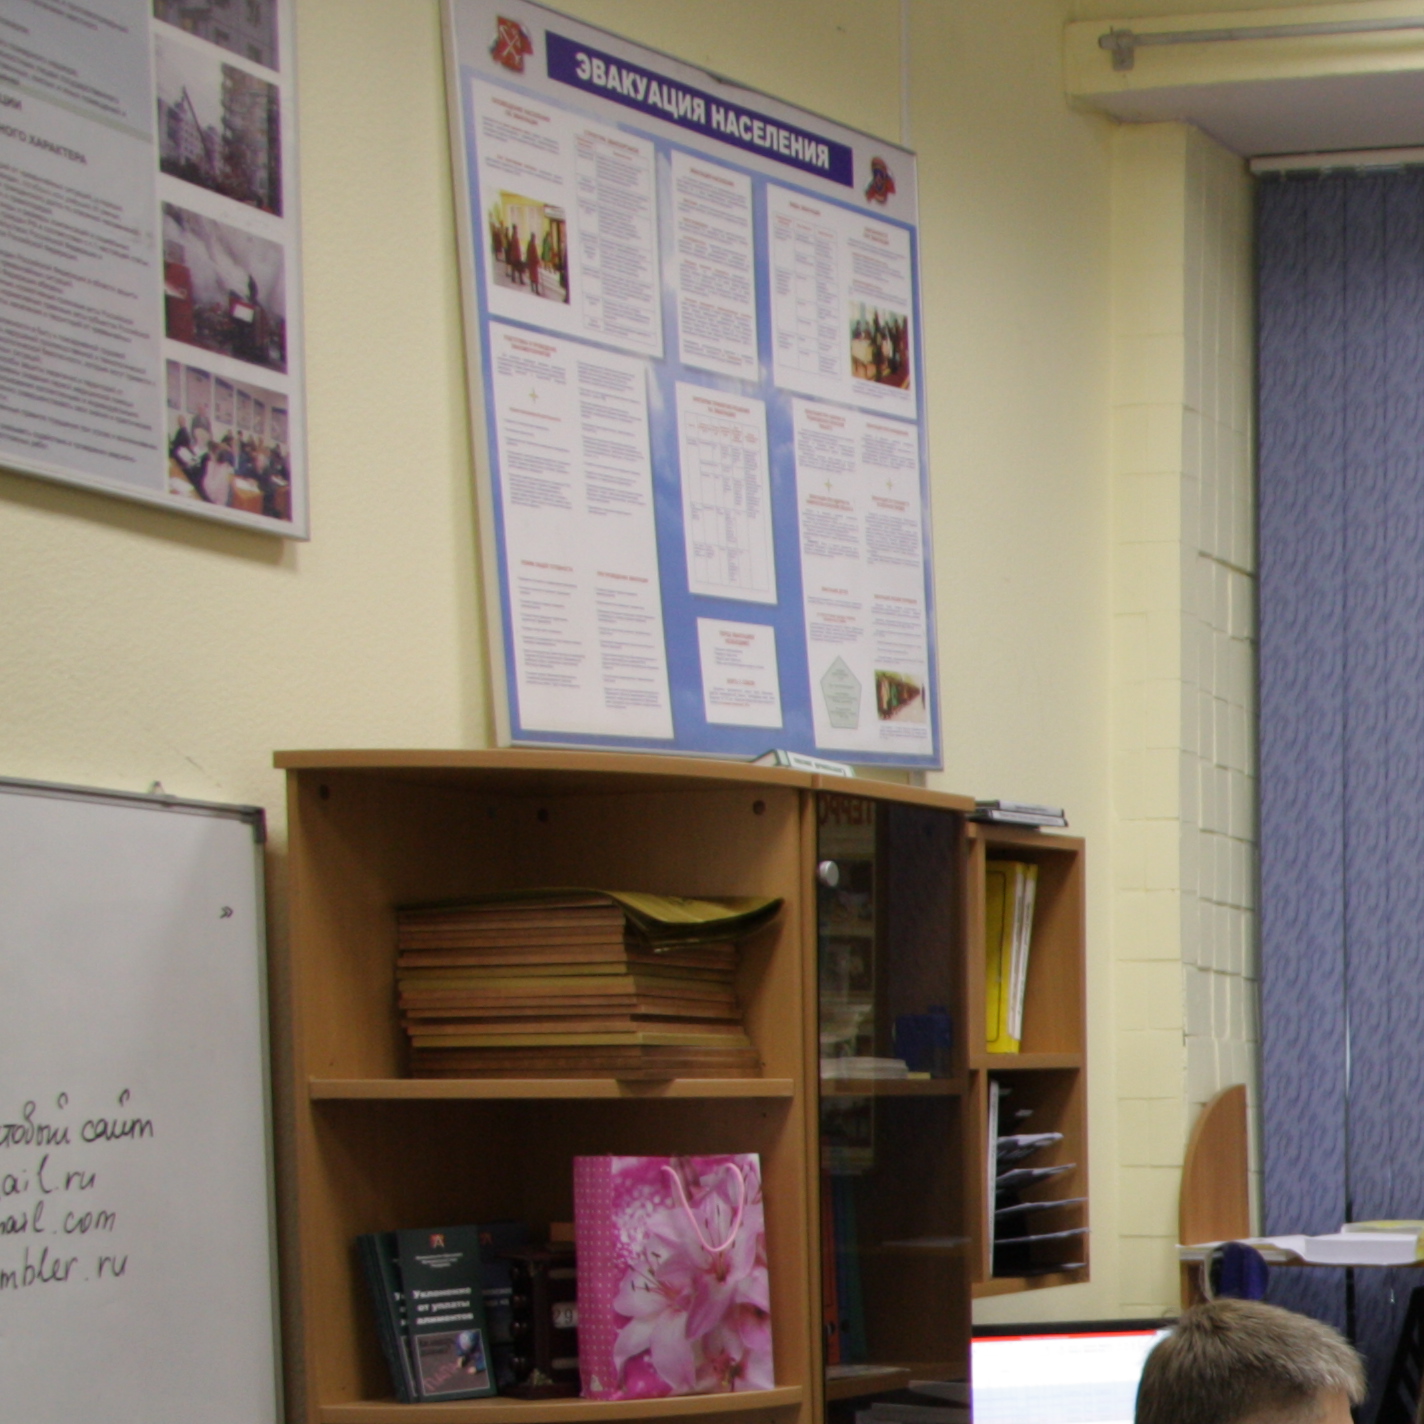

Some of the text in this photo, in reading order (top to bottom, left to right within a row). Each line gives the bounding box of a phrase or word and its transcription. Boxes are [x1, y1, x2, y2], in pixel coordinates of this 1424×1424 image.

[575, 52, 830, 170] ЭВАКУАЦИЯ НАСЕЛЕНИЯ
[80, 1088, 154, 1143] сайт
[413, 1286, 472, 1300] Уклонение
[417, 1300, 471, 1314] от уплаты
[416, 1312, 474, 1326] алиментов
